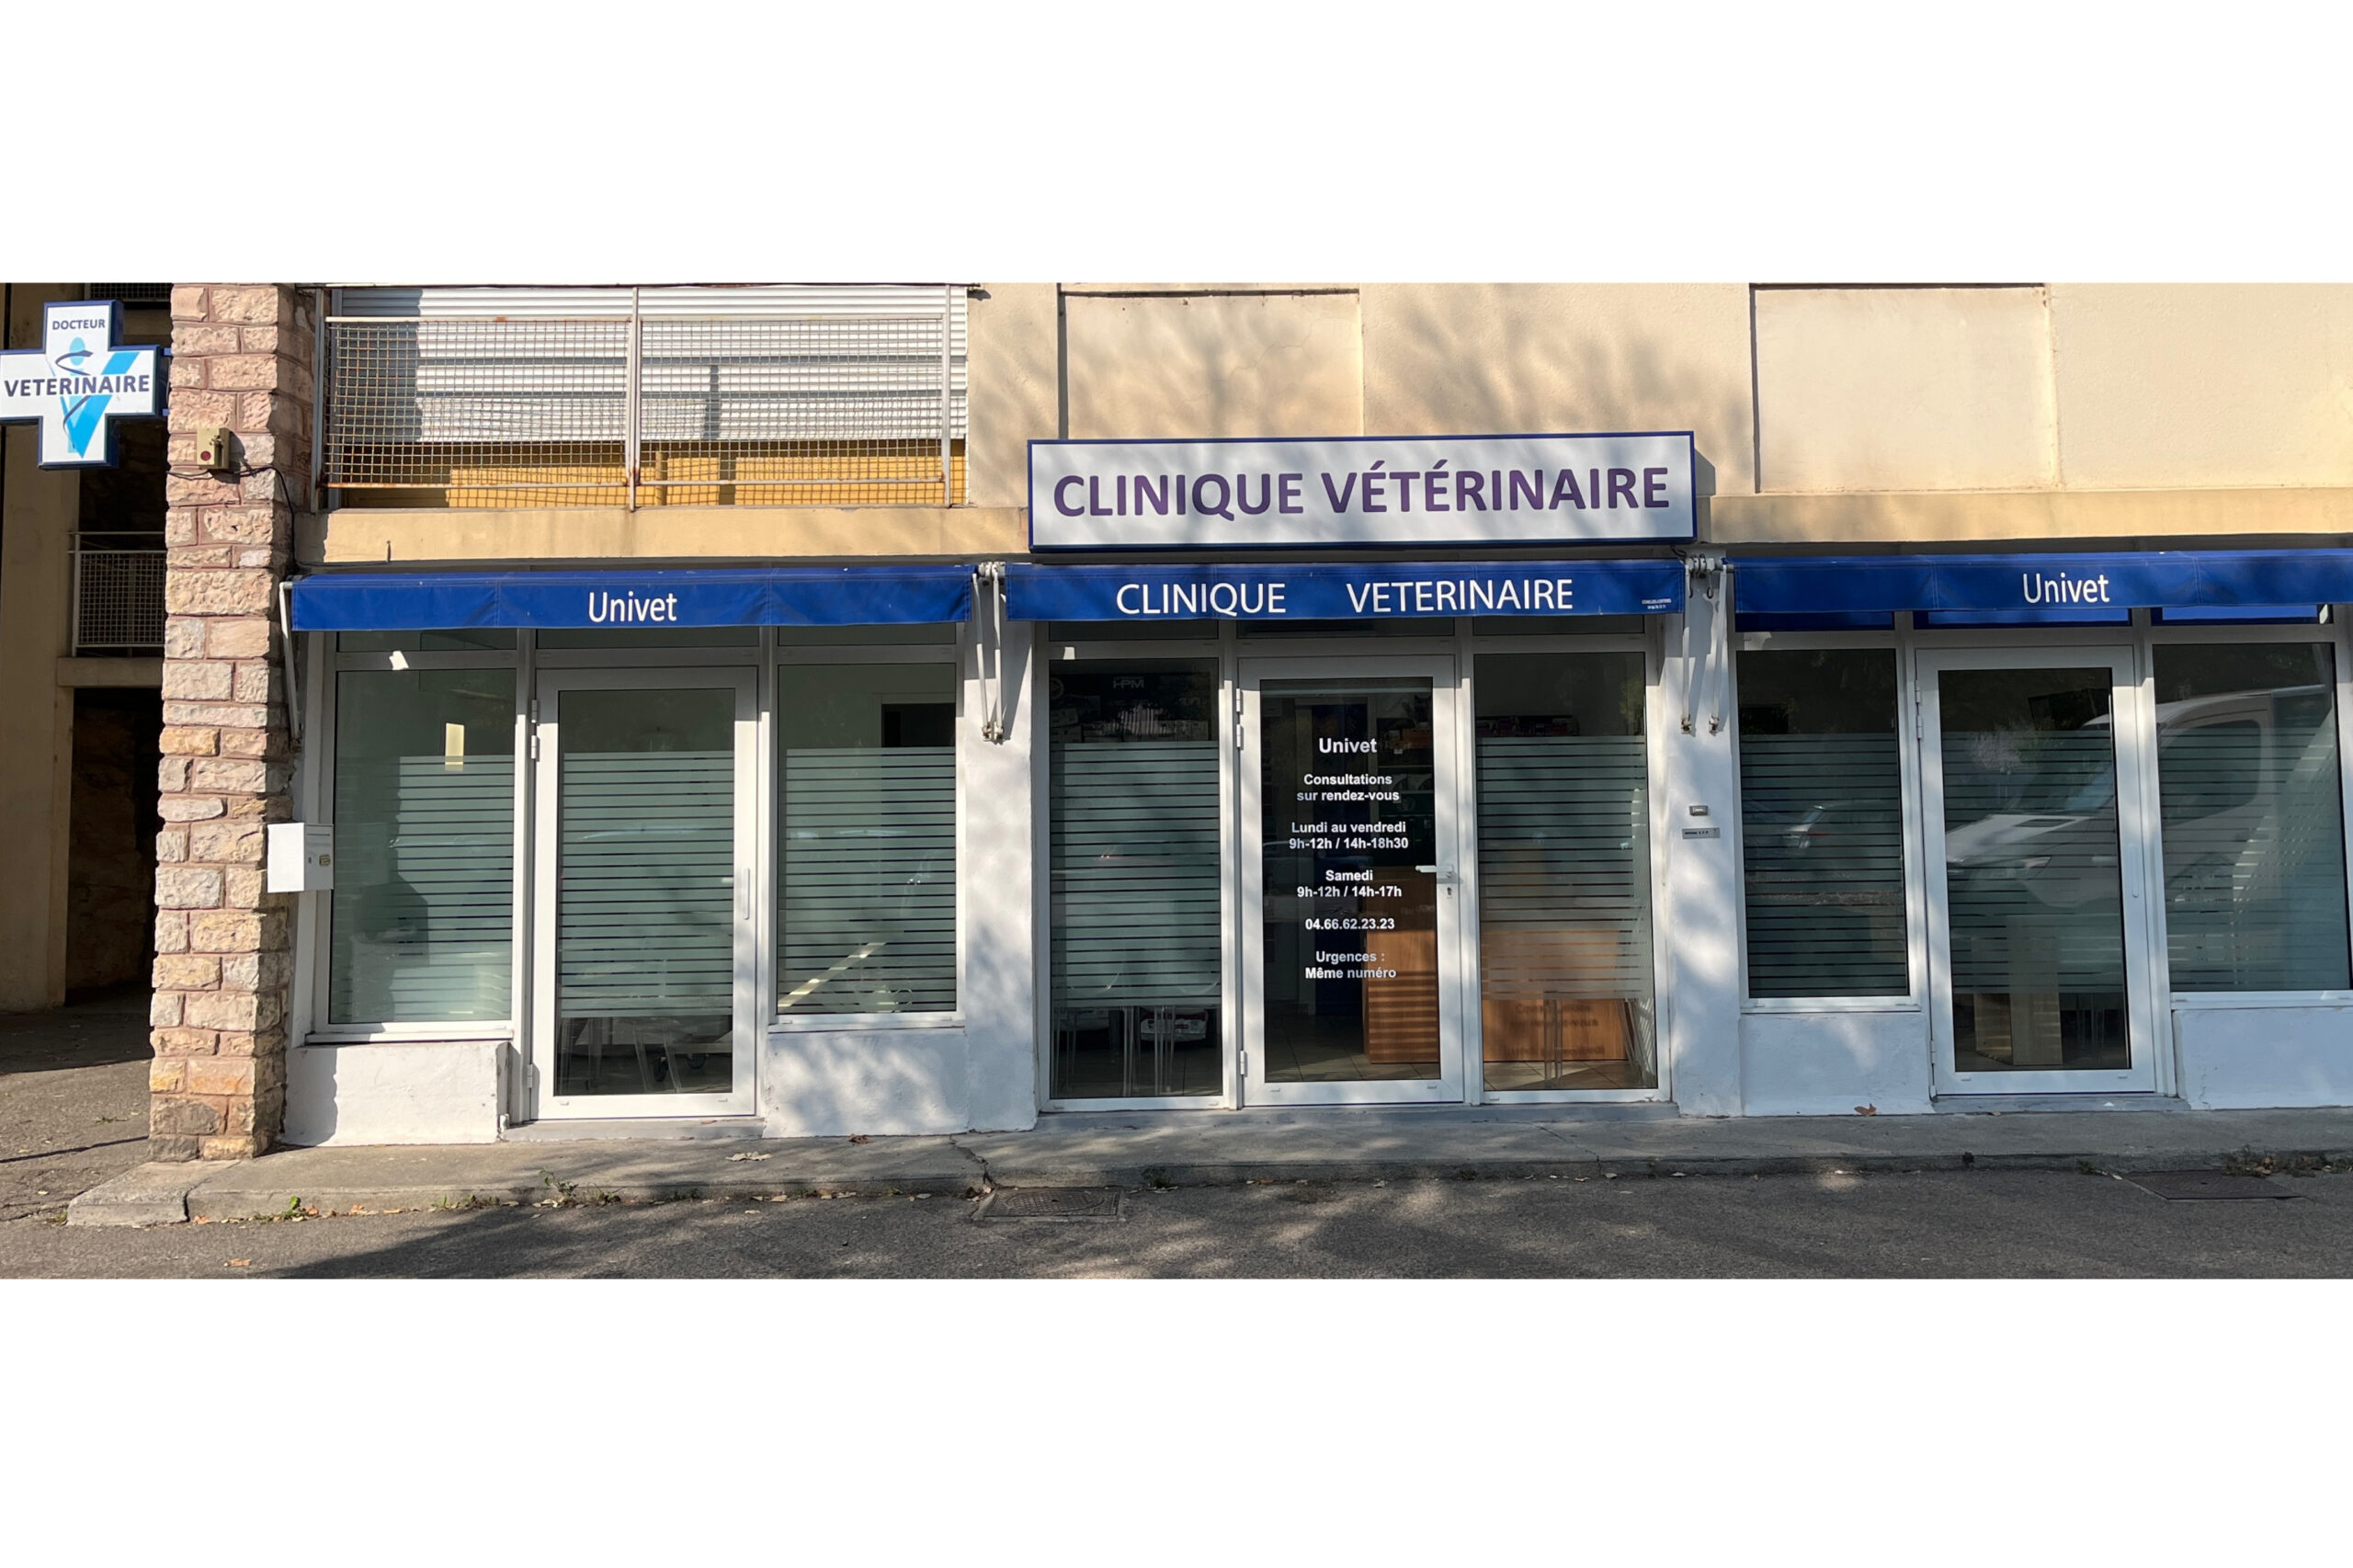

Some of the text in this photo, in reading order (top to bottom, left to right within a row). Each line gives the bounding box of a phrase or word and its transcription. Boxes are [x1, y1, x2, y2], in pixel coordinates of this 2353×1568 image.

[52, 318, 105, 330] DOCTEUR
[5, 375, 150, 397] VETERINAIRE
[1053, 459, 1670, 522] CLINIQUE VÉTÉRINAIRE
[2023, 572, 2110, 604] Univet
[1116, 579, 1574, 617] CLINIQUE VETERINAIRE
[588, 590, 677, 623] Univet
[1319, 737, 1378, 754] Univet
[1303, 773, 1392, 786] Consultations
[1296, 789, 1401, 801] sur rendez-vous
[1291, 821, 1406, 834] Lundi au vendredi
[1289, 836, 1409, 849] 9h-12h / 14h-18h30
[1325, 869, 1374, 881] Samedi
[1296, 885, 1403, 898] 9h-12h / 14h-17h
[1304, 917, 1395, 930] 04.66.62.23.23
[1315, 950, 1378, 965] Urgences
[1305, 966, 1397, 979] Même numéro
